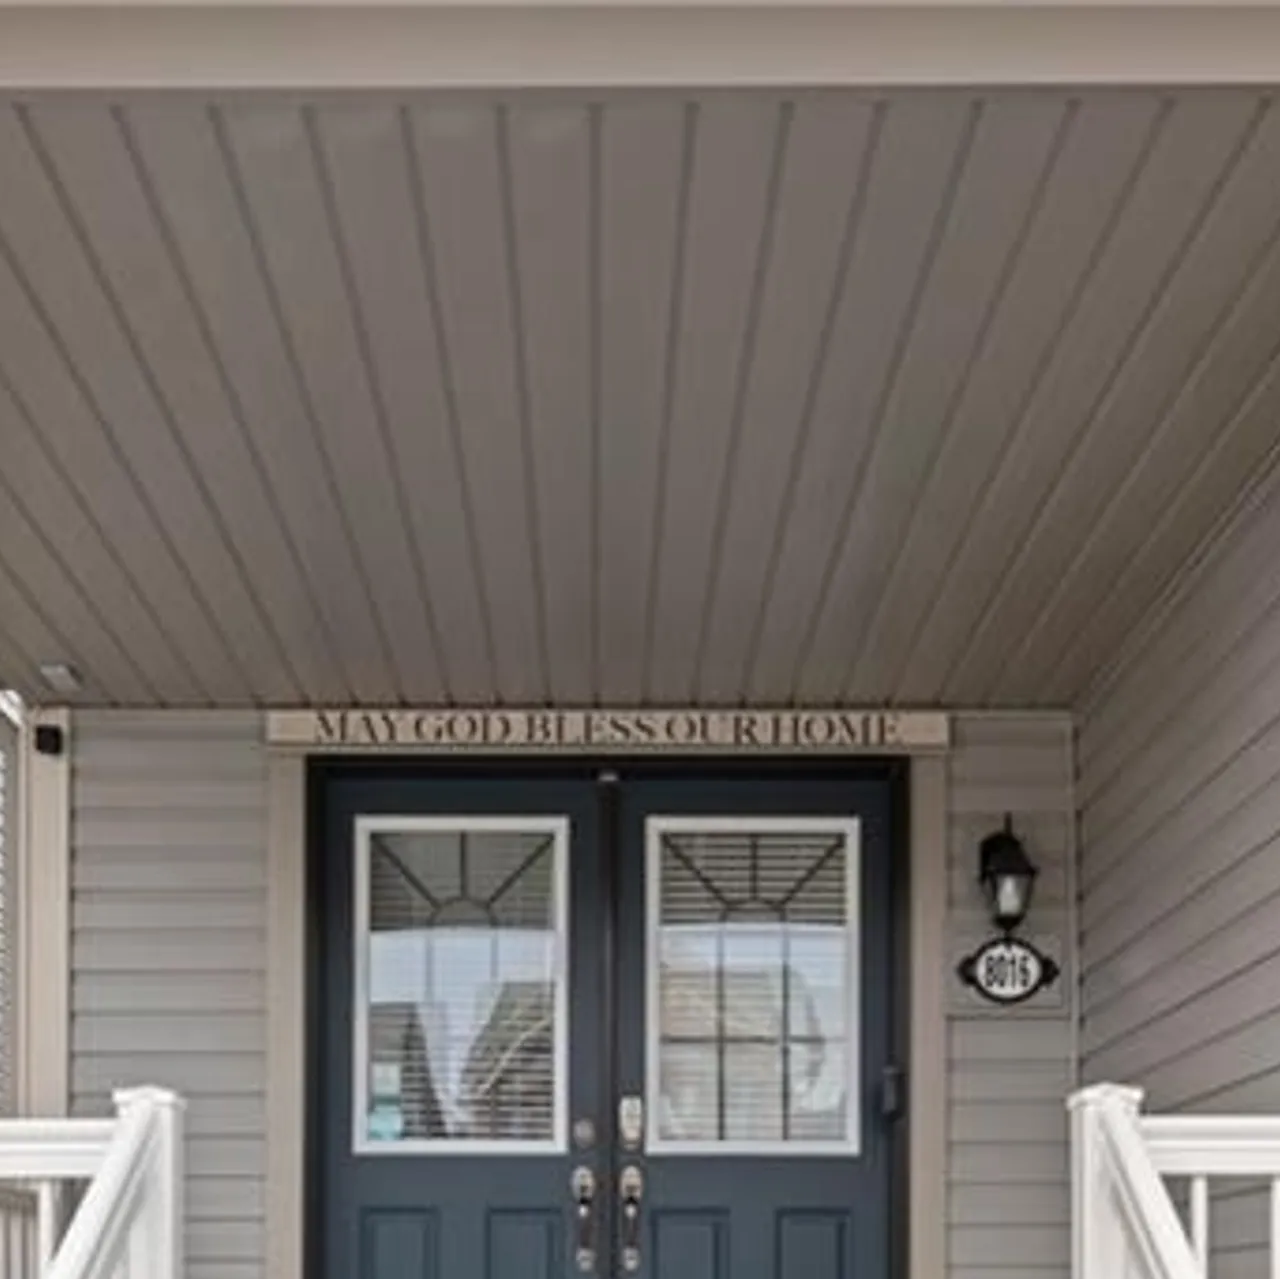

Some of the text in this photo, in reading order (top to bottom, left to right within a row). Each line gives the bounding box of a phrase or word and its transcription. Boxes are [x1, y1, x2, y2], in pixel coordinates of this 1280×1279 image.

[317, 713, 901, 746] MAY GOD BLESS OUR HOME
